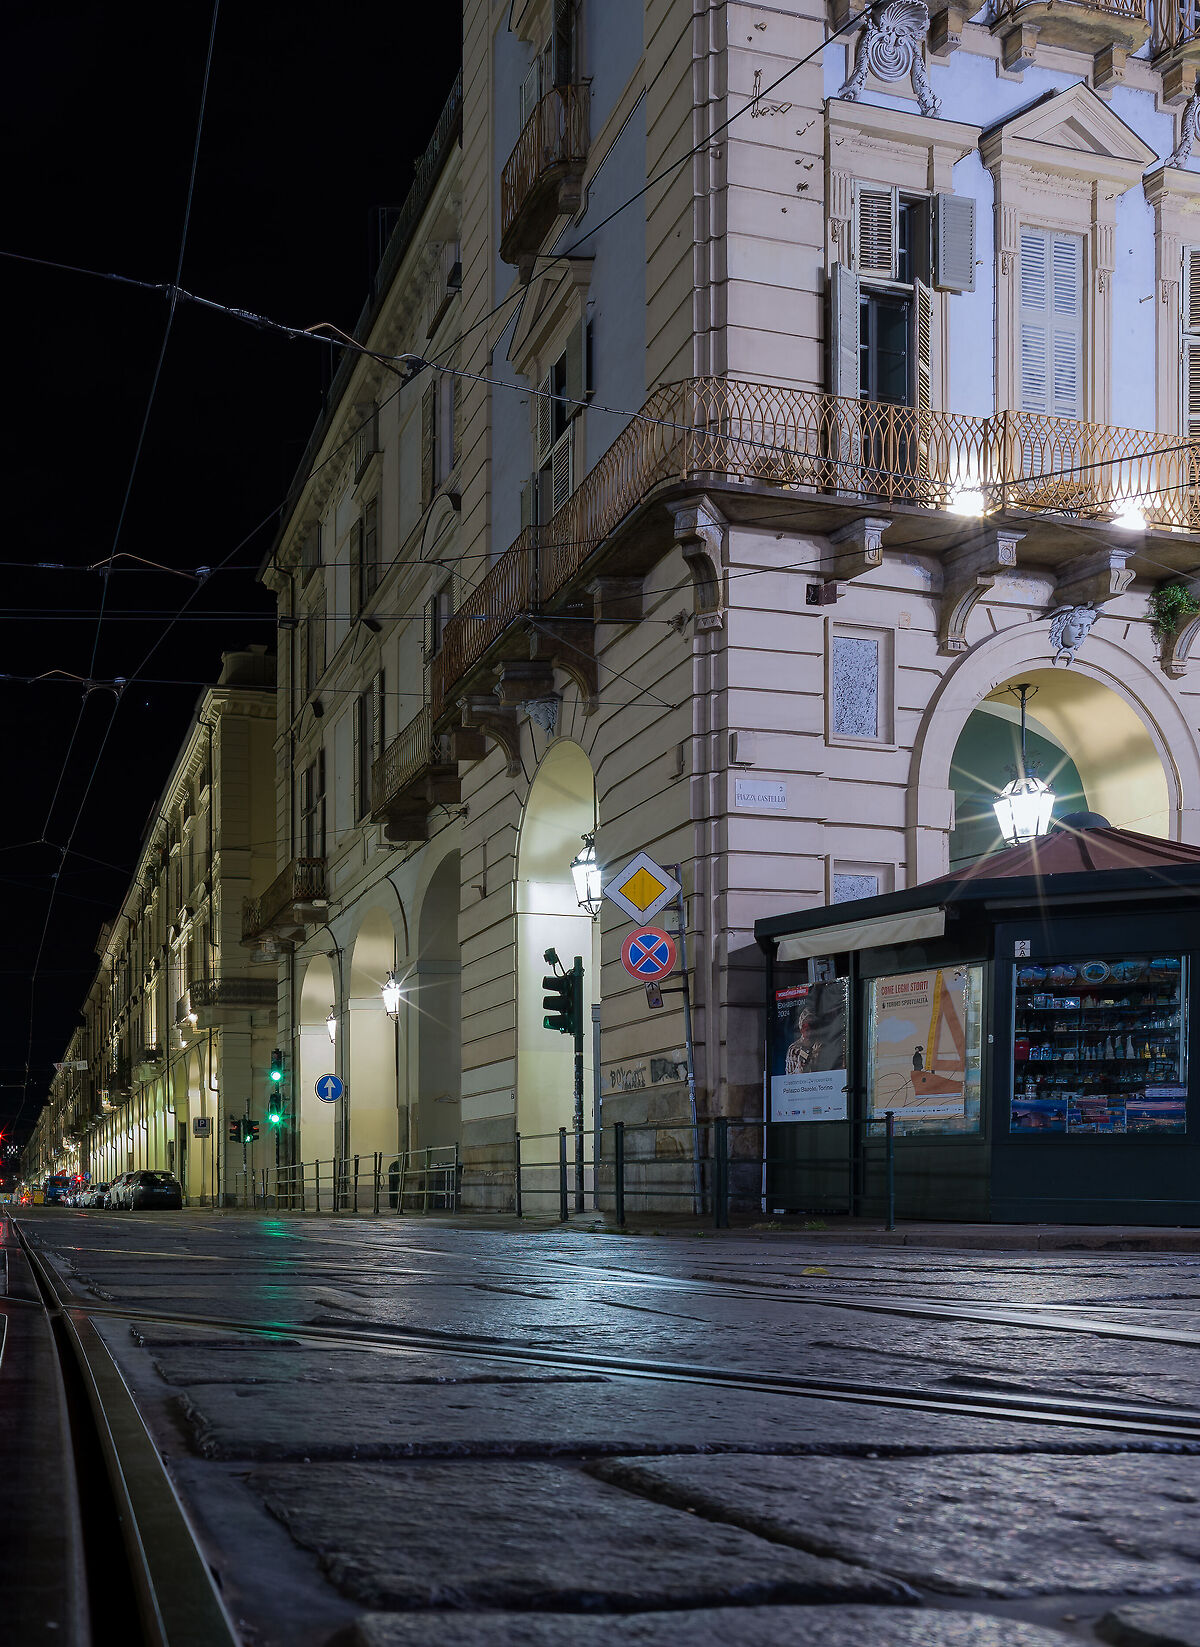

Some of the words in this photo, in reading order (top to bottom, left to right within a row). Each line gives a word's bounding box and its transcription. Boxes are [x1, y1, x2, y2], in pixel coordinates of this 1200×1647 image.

[736, 793, 756, 802] PIAZZA
[757, 794, 786, 803] CASTELLO
[1019, 941, 1026, 949] 2
[1019, 949, 1026, 957] A
[910, 980, 929, 992] STORTI
